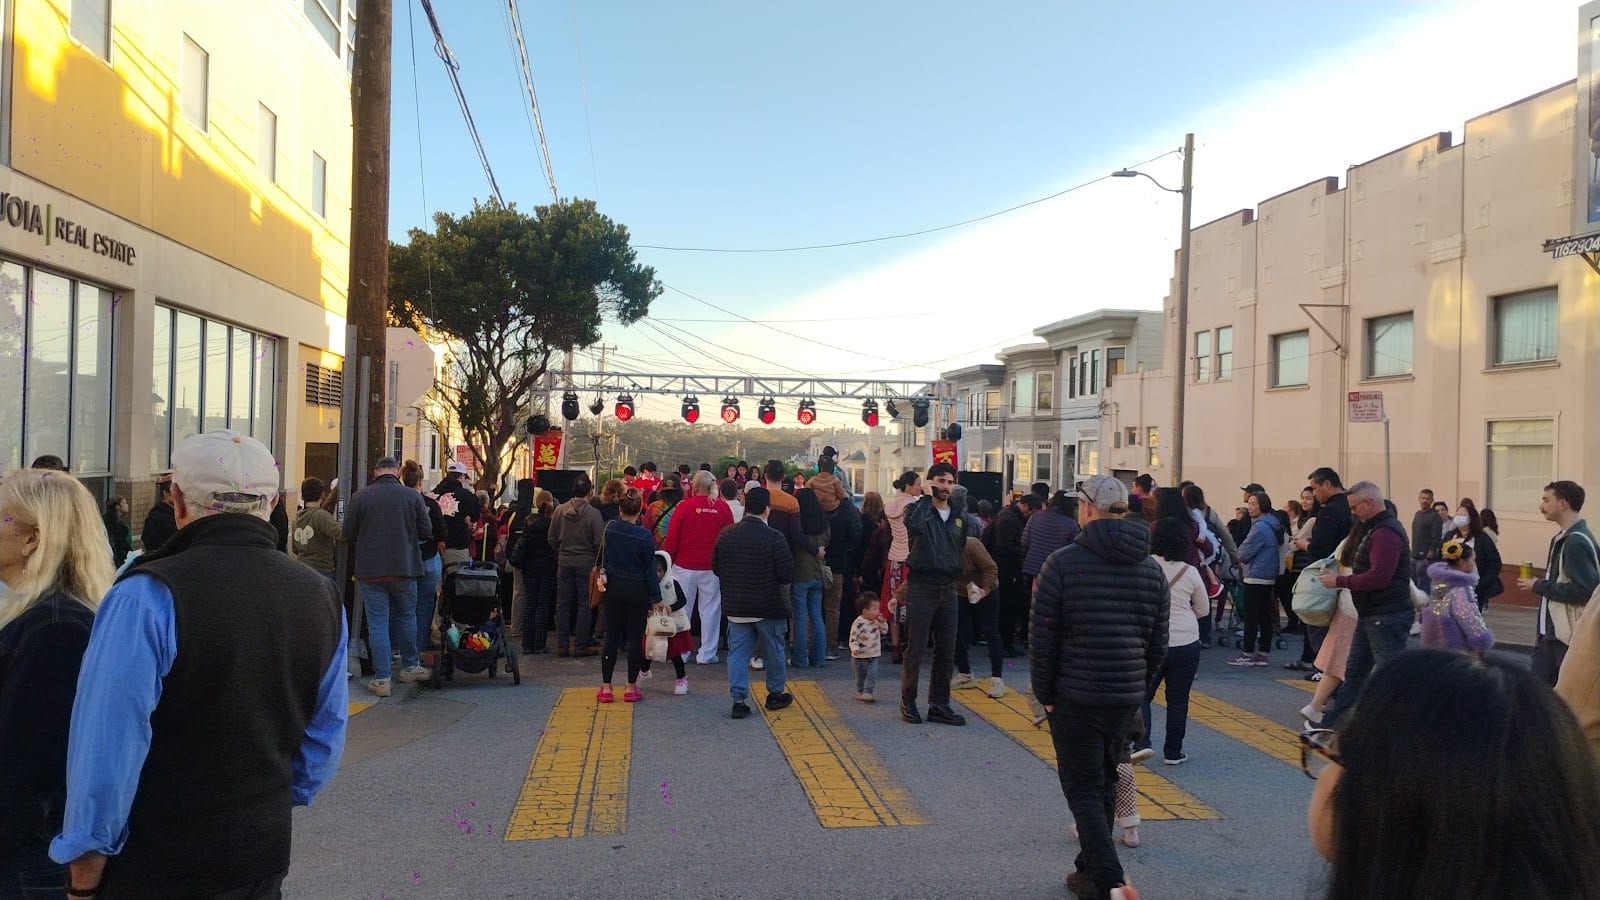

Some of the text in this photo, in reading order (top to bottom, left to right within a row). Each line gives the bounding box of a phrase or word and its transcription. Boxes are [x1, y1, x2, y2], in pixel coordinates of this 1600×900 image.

[55, 216, 90, 250] REAL
[93, 232, 136, 266] ESTATE
[1349, 393, 1359, 401] NO
[536, 444, 557, 470] 萬
